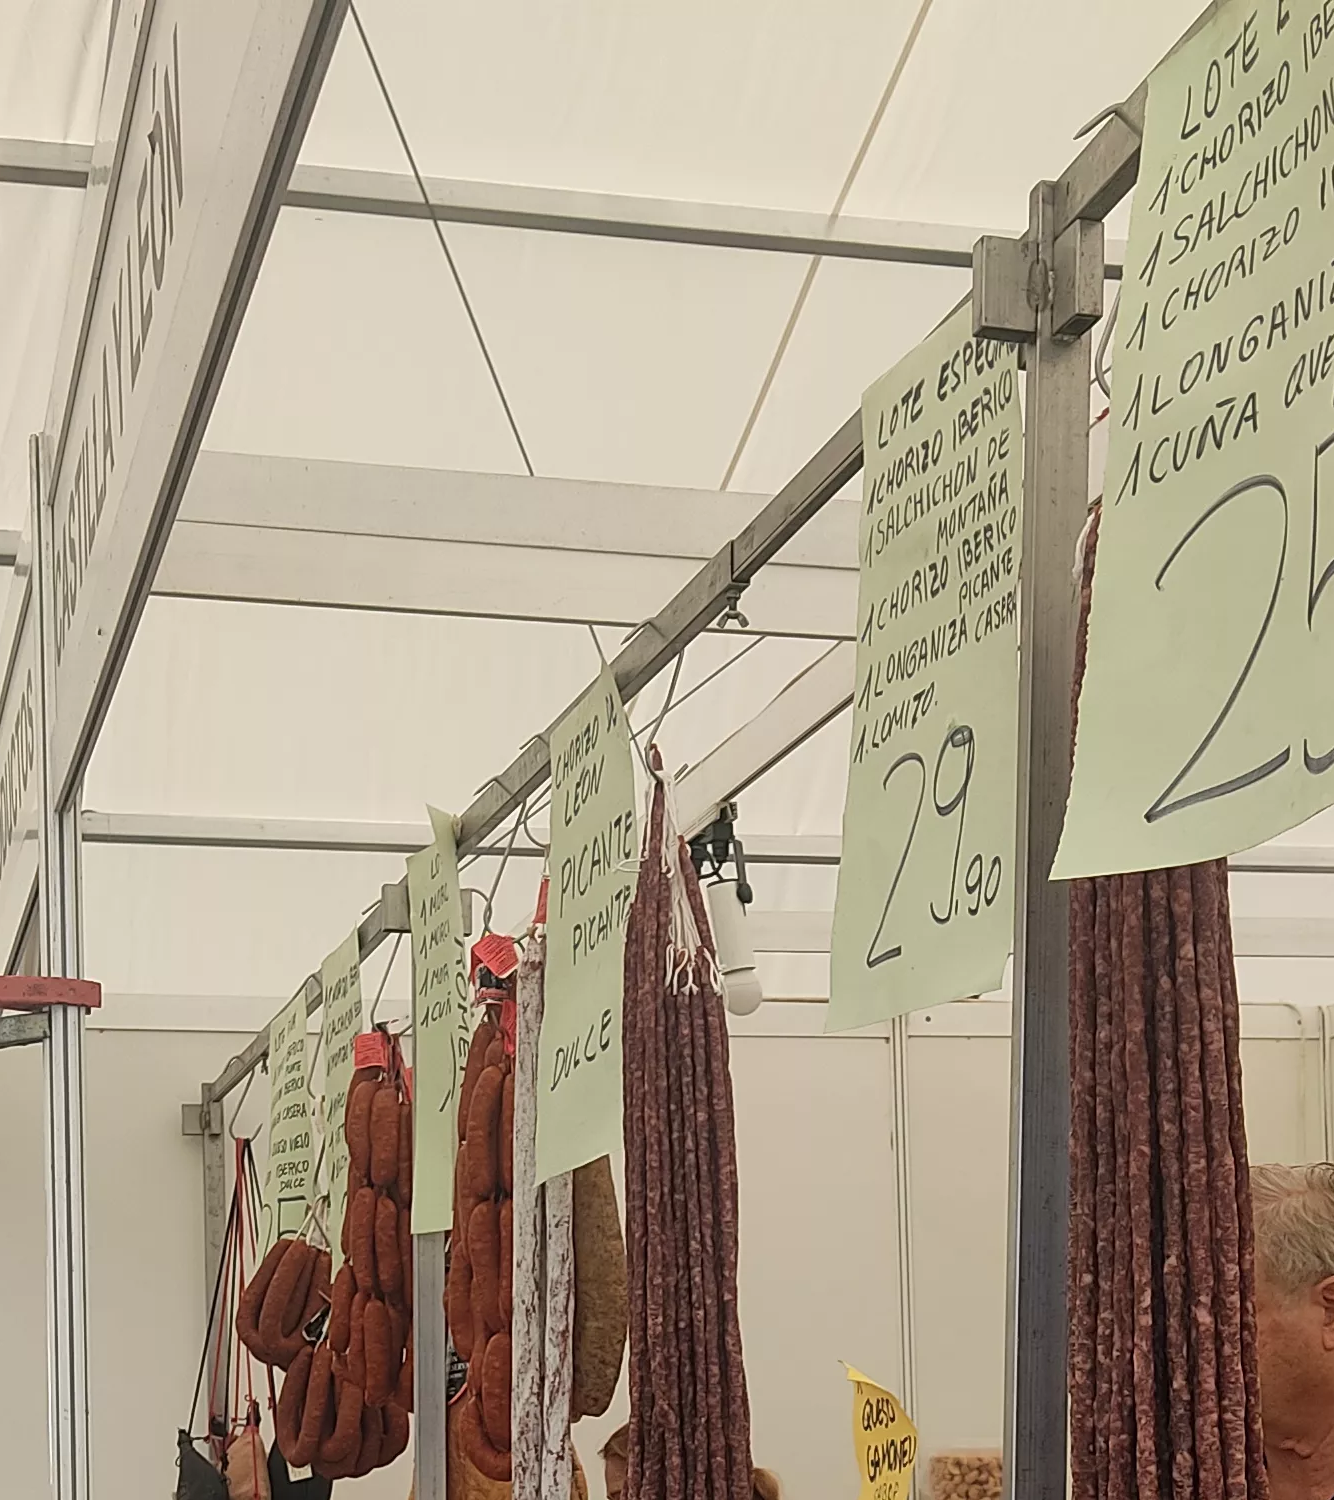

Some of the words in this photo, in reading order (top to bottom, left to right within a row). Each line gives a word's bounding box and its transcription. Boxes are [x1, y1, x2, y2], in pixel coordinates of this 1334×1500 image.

[1179, 60, 1290, 194] CHORIZO
[1181, 9, 1259, 139] LOTE
[1126, 302, 1148, 351] 1
[1162, 207, 1299, 329] CHORIZO
[54, 345, 114, 667] CASTILLA
[113, 268, 123, 436] Y
[127, 22, 183, 393] LEÓN
[878, 378, 925, 449] LOTE
[952, 369, 1013, 451] IBERICO
[875, 447, 979, 555] SALCHICHON
[988, 427, 1010, 468] DE
[877, 555, 949, 630] CHORIZO
[958, 505, 1017, 578] IBERICO
[959, 546, 1014, 614] PICANTE
[874, 613, 967, 697] LONGANIZA
[560, 810, 632, 918] PICANTE
[551, 1009, 612, 1092] DULCE
